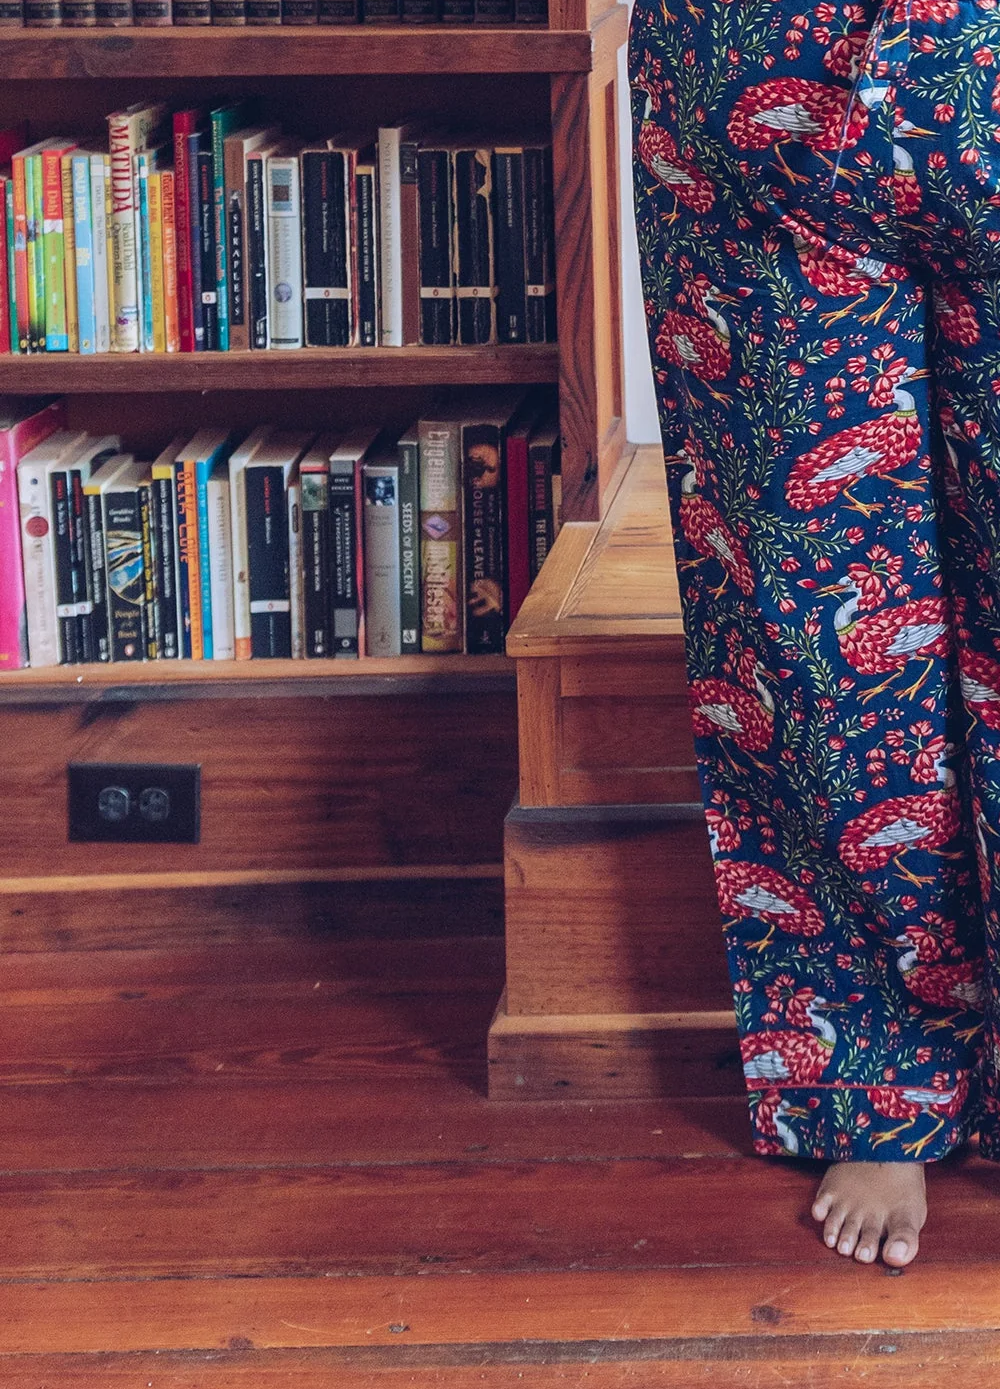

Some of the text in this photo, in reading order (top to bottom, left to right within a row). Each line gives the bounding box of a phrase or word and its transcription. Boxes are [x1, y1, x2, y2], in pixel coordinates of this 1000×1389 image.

[46, 155, 60, 216] Roald Dahl
[110, 124, 133, 214] MATILDA
[401, 502, 412, 534] SEEDS
